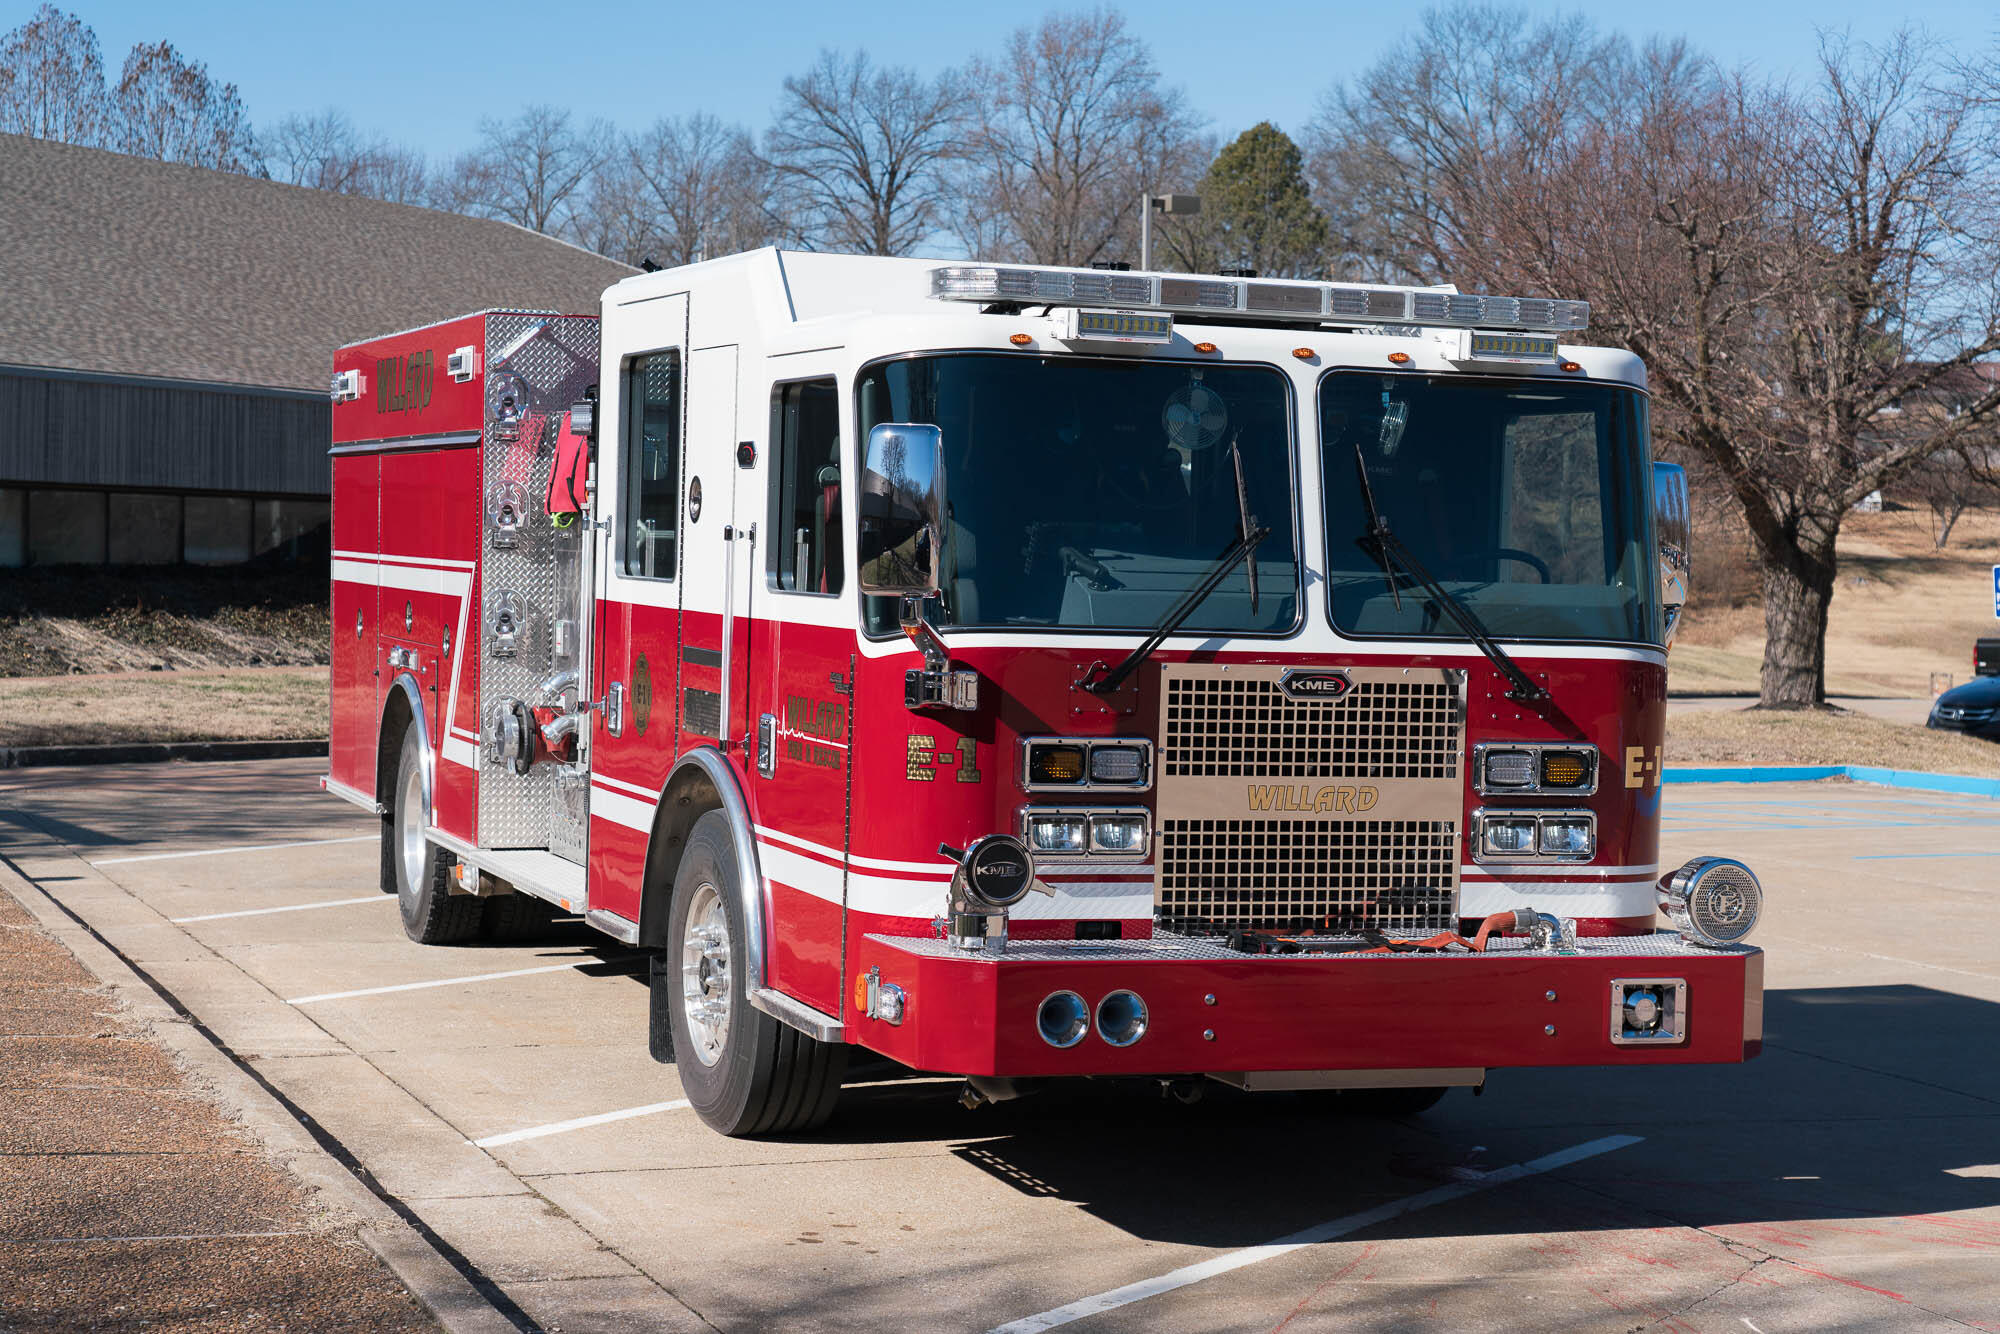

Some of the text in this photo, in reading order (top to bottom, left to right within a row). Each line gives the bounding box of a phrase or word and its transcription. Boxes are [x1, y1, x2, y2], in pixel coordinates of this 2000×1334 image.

[377, 350, 433, 416] WILLARD
[1291, 680, 1335, 690] KME
[787, 695, 845, 742] WILLARD
[906, 735, 981, 783] E-1
[1248, 785, 1379, 814] WILLARD
[976, 865, 1017, 876] KME
